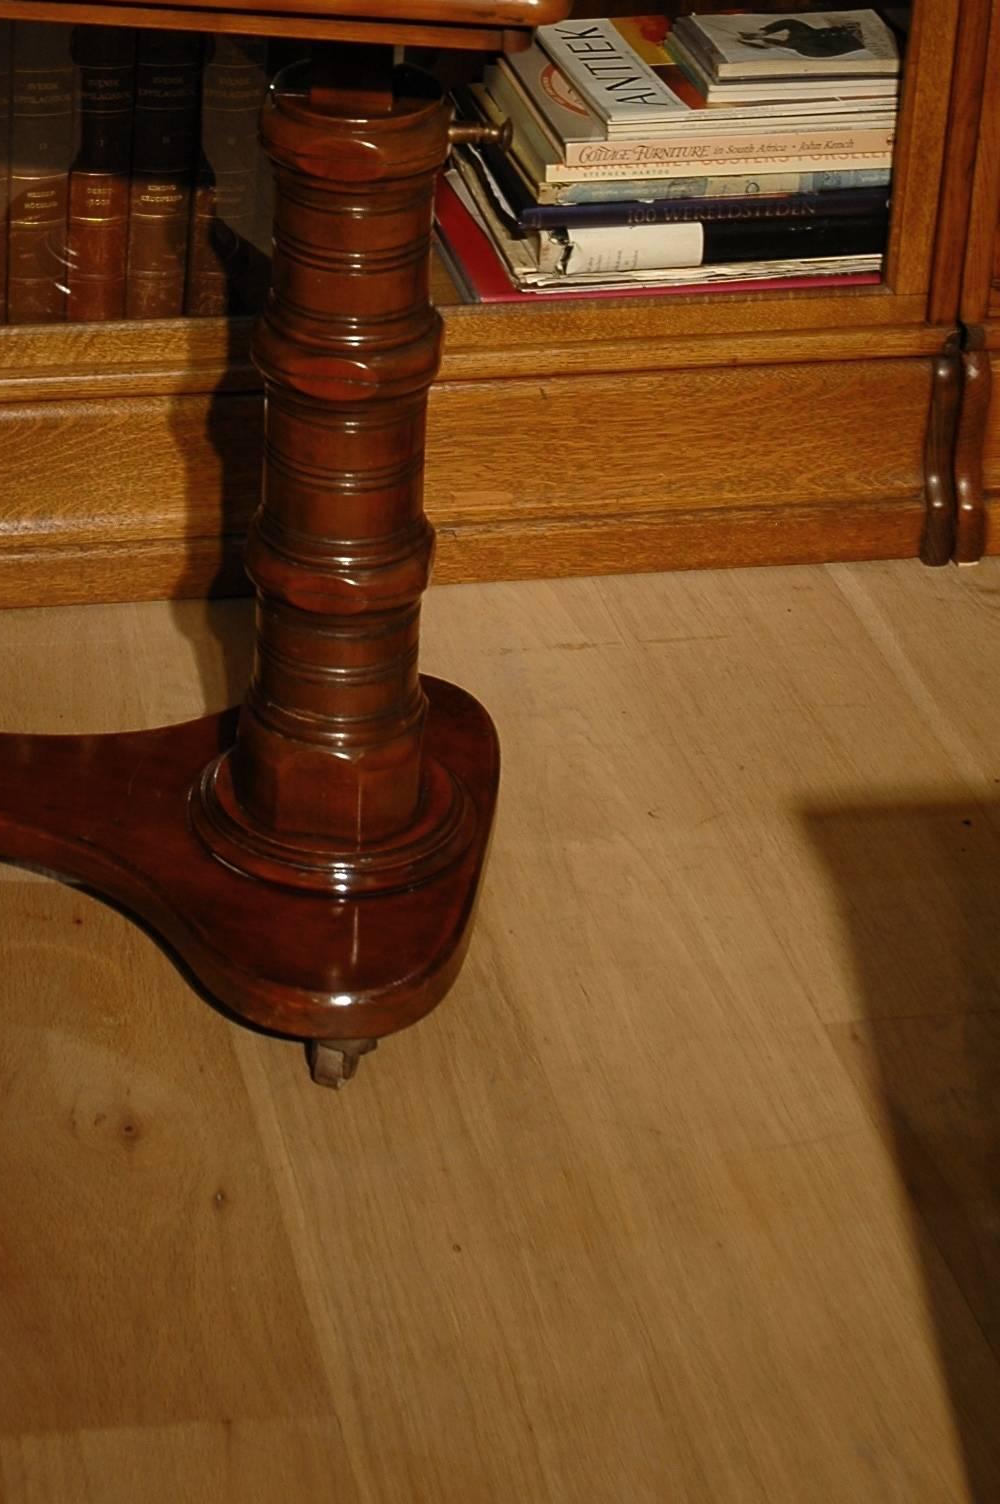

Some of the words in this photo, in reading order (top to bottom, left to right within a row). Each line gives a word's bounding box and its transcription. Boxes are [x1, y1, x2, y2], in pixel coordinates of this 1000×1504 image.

[554, 27, 668, 106] ANTIEK
[578, 146, 633, 164] COTTAGE
[633, 144, 711, 161] FURNITURE
[713, 146, 725, 155] in
[727, 143, 755, 154] South
[756, 142, 787, 153] Africa
[798, 141, 822, 152] John
[583, 170, 627, 178] STEPHEN
[633, 169, 670, 177] HARTOG
[627, 207, 656, 224] 100
[664, 201, 816, 222] WERELDSTEDEN
